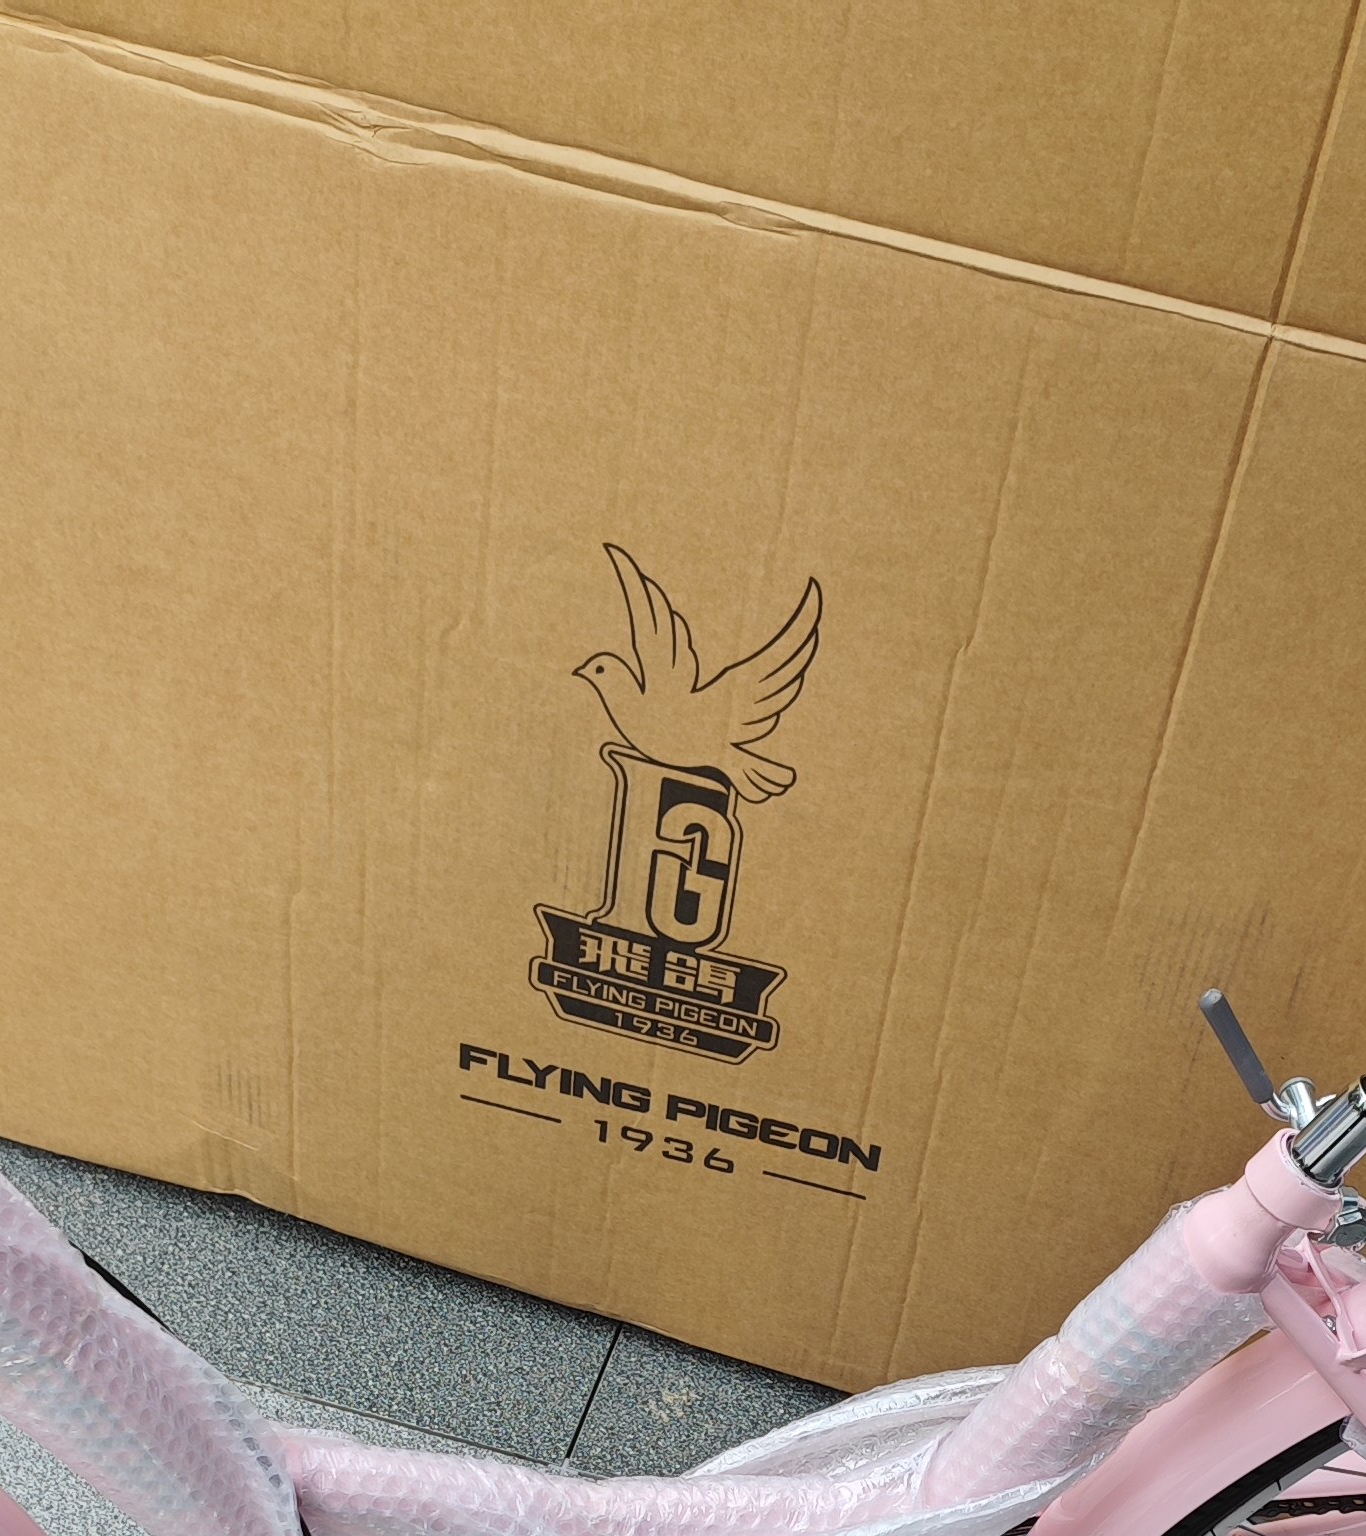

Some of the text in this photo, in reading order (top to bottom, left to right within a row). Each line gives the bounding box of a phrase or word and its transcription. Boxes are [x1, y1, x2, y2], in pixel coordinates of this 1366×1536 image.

[553, 971, 758, 1038] FLYING PIGEON
[614, 1012, 699, 1047] 1936
[458, 1042, 882, 1173] FLYING PIGEON
[594, 1119, 735, 1174] 1936
